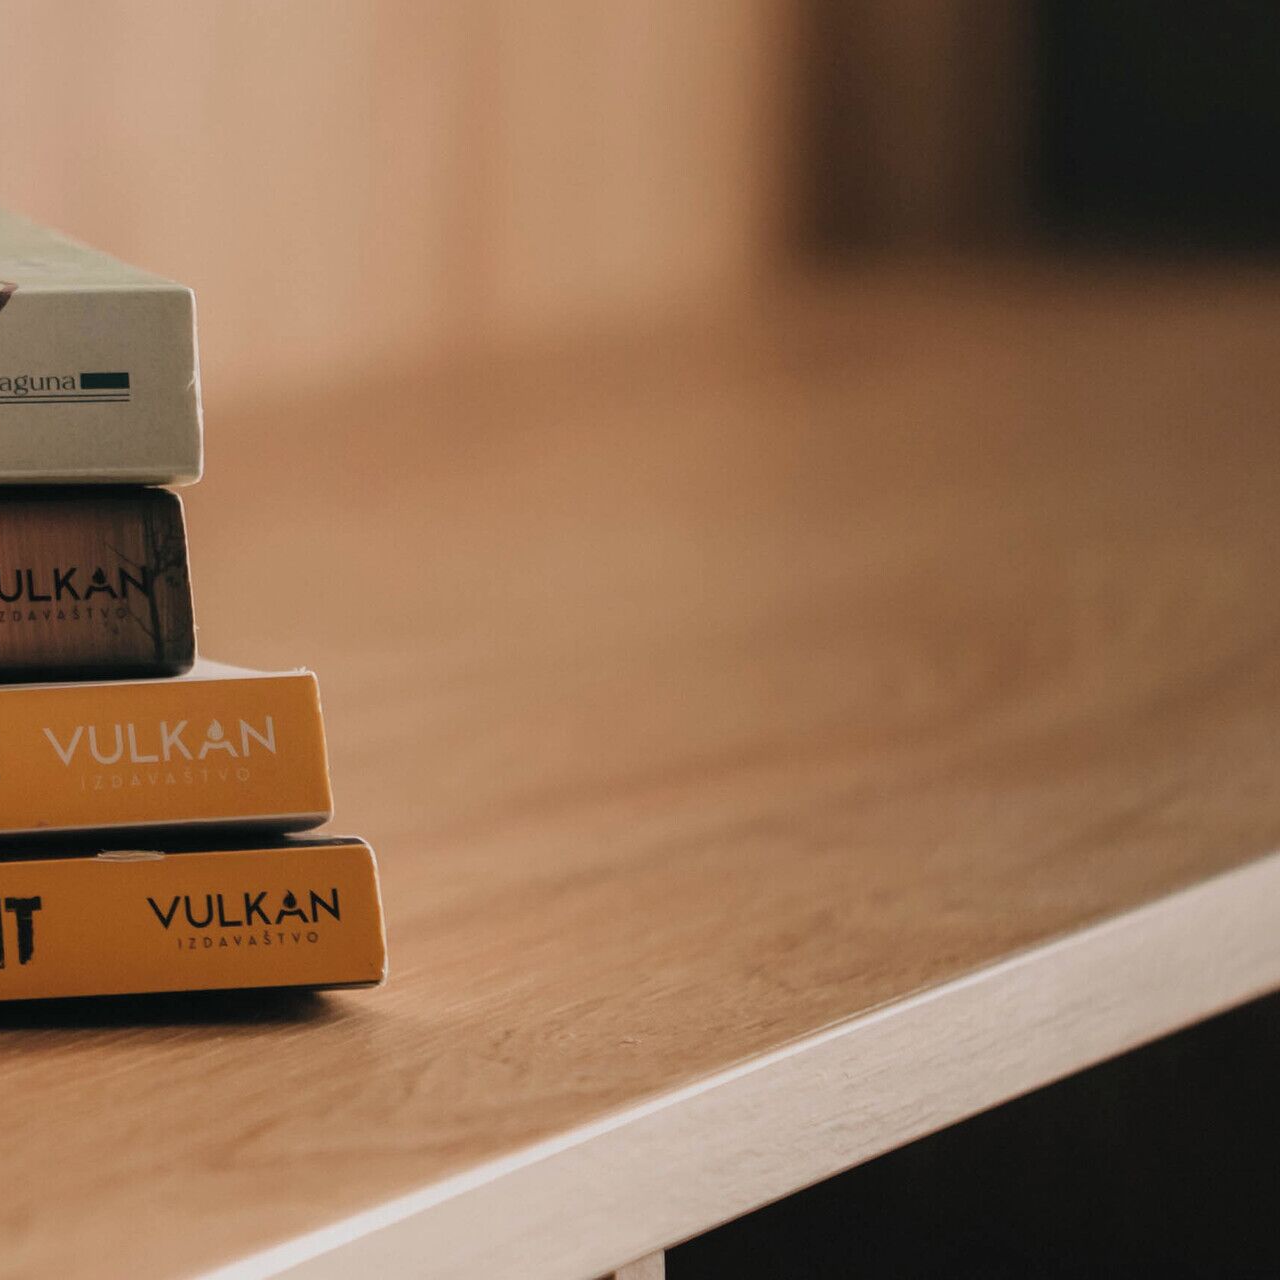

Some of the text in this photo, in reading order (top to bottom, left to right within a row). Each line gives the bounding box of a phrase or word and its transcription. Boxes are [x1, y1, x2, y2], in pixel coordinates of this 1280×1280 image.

[43, 715, 277, 766] VULKAN
[146, 887, 341, 930] VULKAN
[177, 930, 320, 950] IZDAVAŠTVO
